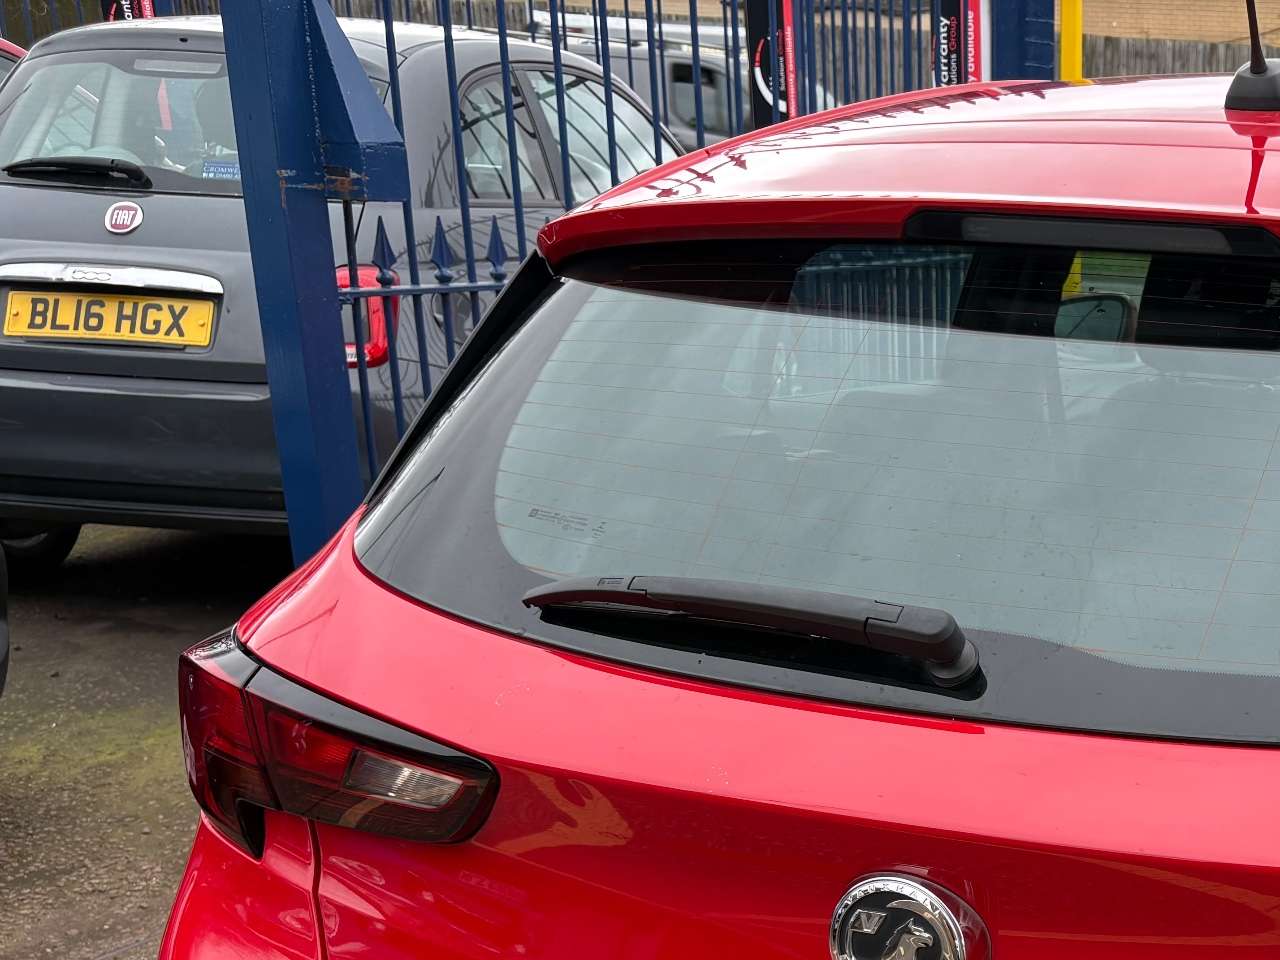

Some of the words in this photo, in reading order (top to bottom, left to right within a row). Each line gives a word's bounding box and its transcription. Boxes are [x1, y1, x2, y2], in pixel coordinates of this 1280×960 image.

[949, 16, 957, 50] Group
[949, 53, 958, 84] utions
[111, 209, 136, 226] FIAT
[71, 268, 112, 281] 500
[27, 297, 106, 333] BL16
[114, 300, 189, 338] HGX
